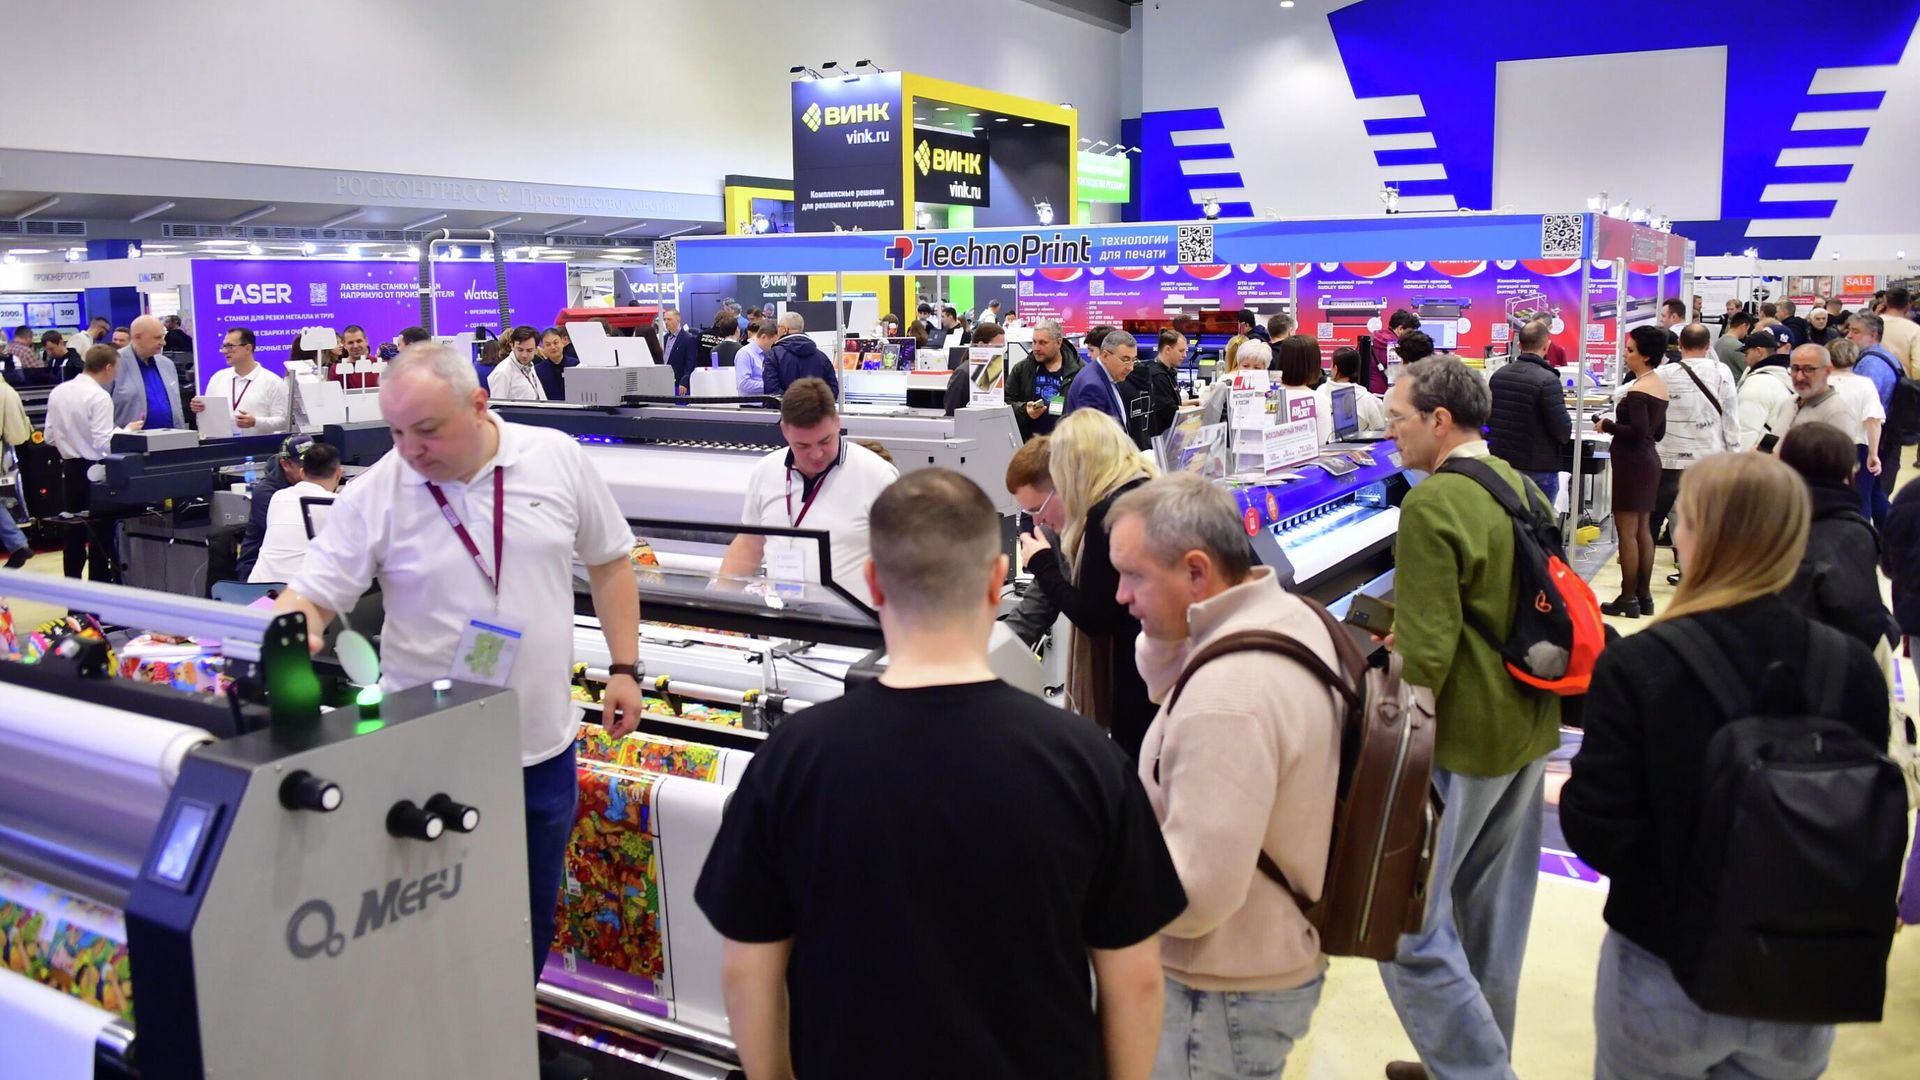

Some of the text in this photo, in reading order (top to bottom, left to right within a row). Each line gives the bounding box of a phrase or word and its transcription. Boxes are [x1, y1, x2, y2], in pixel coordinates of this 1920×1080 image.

[824, 102, 890, 125] ВИНК
[846, 129, 890, 144] vink.ru
[932, 148, 981, 175] ВИНК
[335, 175, 489, 203] РОСКОНГРЕСС
[810, 189, 885, 199] Комплексные решения
[949, 180, 981, 200] vink.ru
[801, 199, 894, 211] для рекламных производств
[1101, 233, 1169, 246] технологии
[917, 234, 1091, 268] TechnoPrint
[1099, 248, 1166, 262] для печати
[340, 283, 380, 291] ЛАЗЕРНЫЕ
[1846, 276, 1873, 286] SALE
[215, 283, 292, 305] LASER
[340, 291, 383, 299] НАПРЯМУЮ
[260, 329, 284, 337] СВАРКИ
